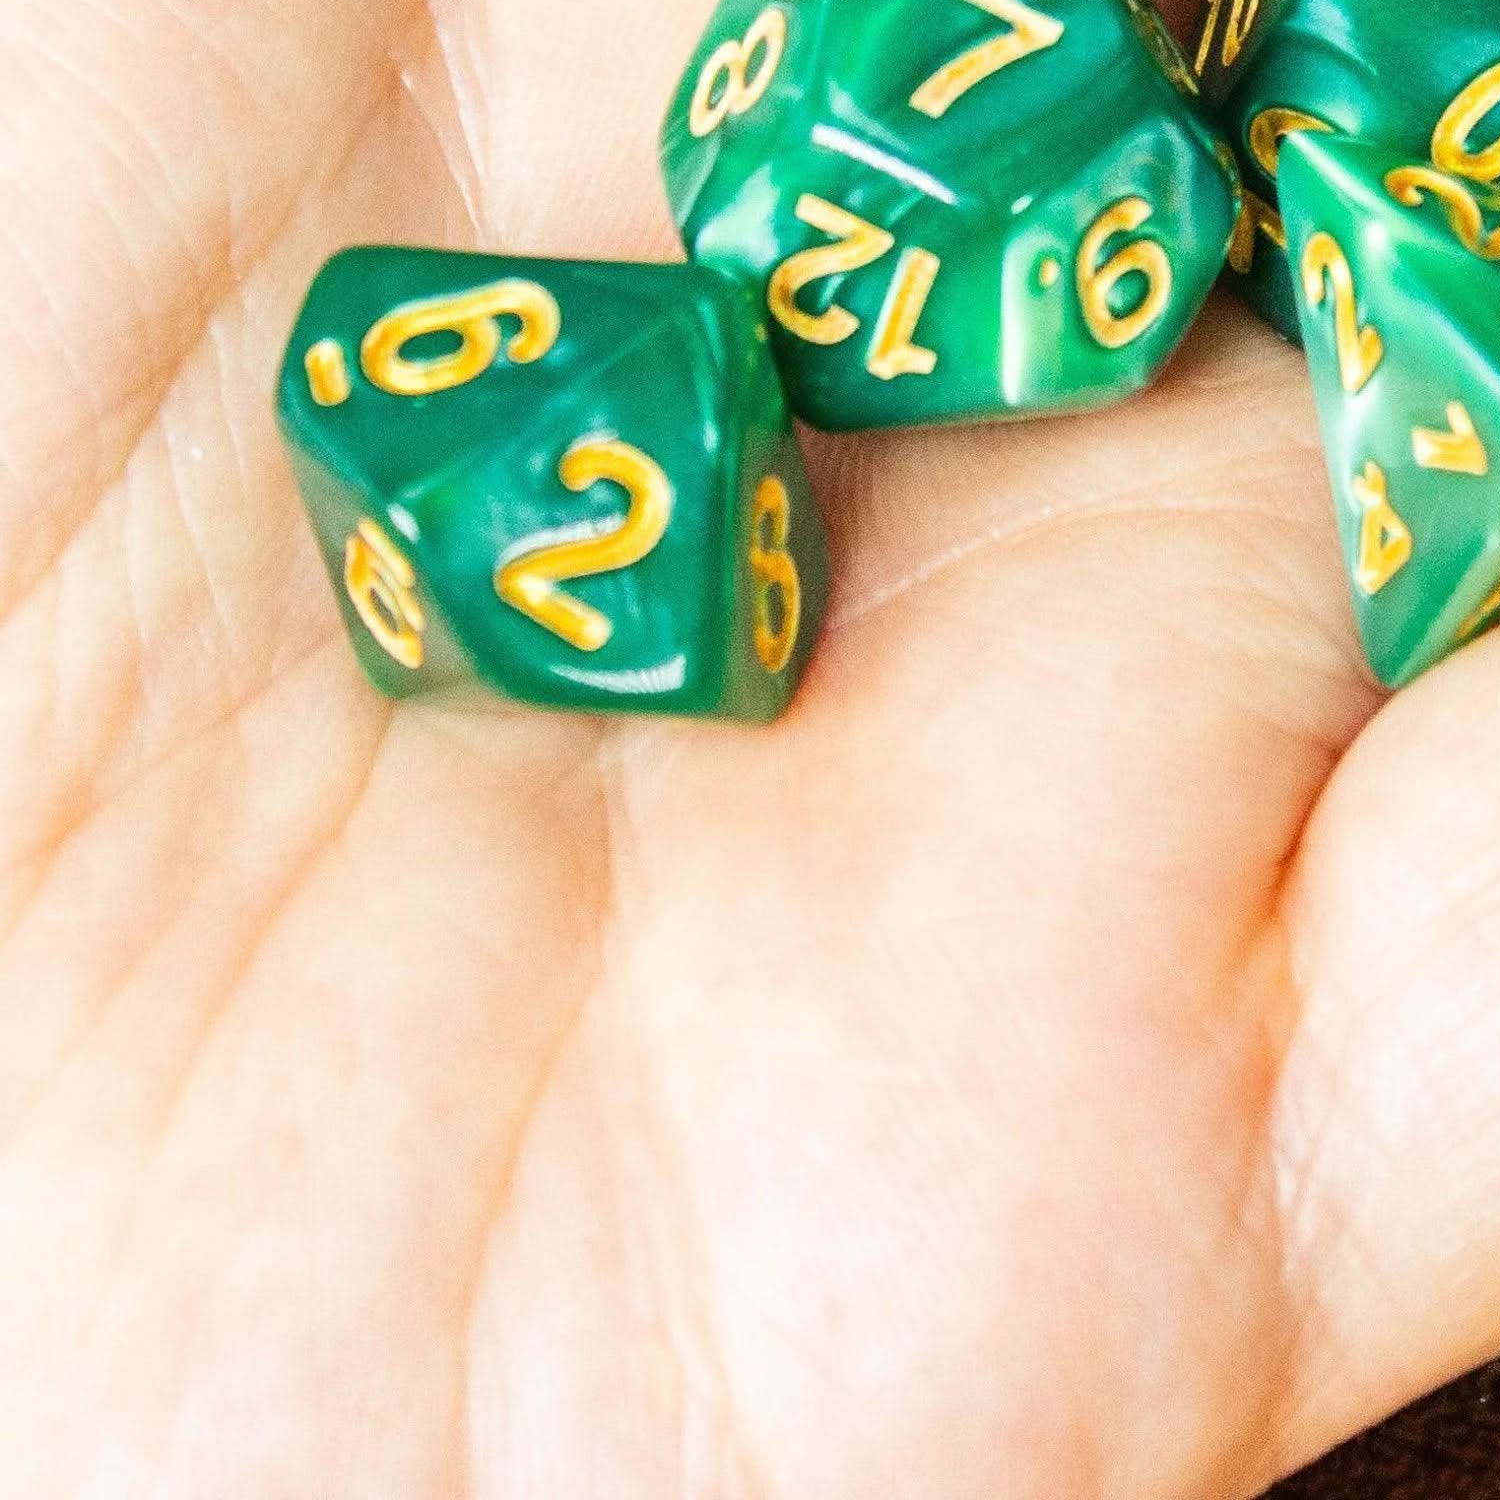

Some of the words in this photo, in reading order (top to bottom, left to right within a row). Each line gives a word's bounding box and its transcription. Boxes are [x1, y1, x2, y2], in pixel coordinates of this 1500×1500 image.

[688, 6, 787, 138] 8
[1302, 231, 1384, 392] 2
[493, 438, 677, 651] 2
[1352, 457, 1413, 596] 4
